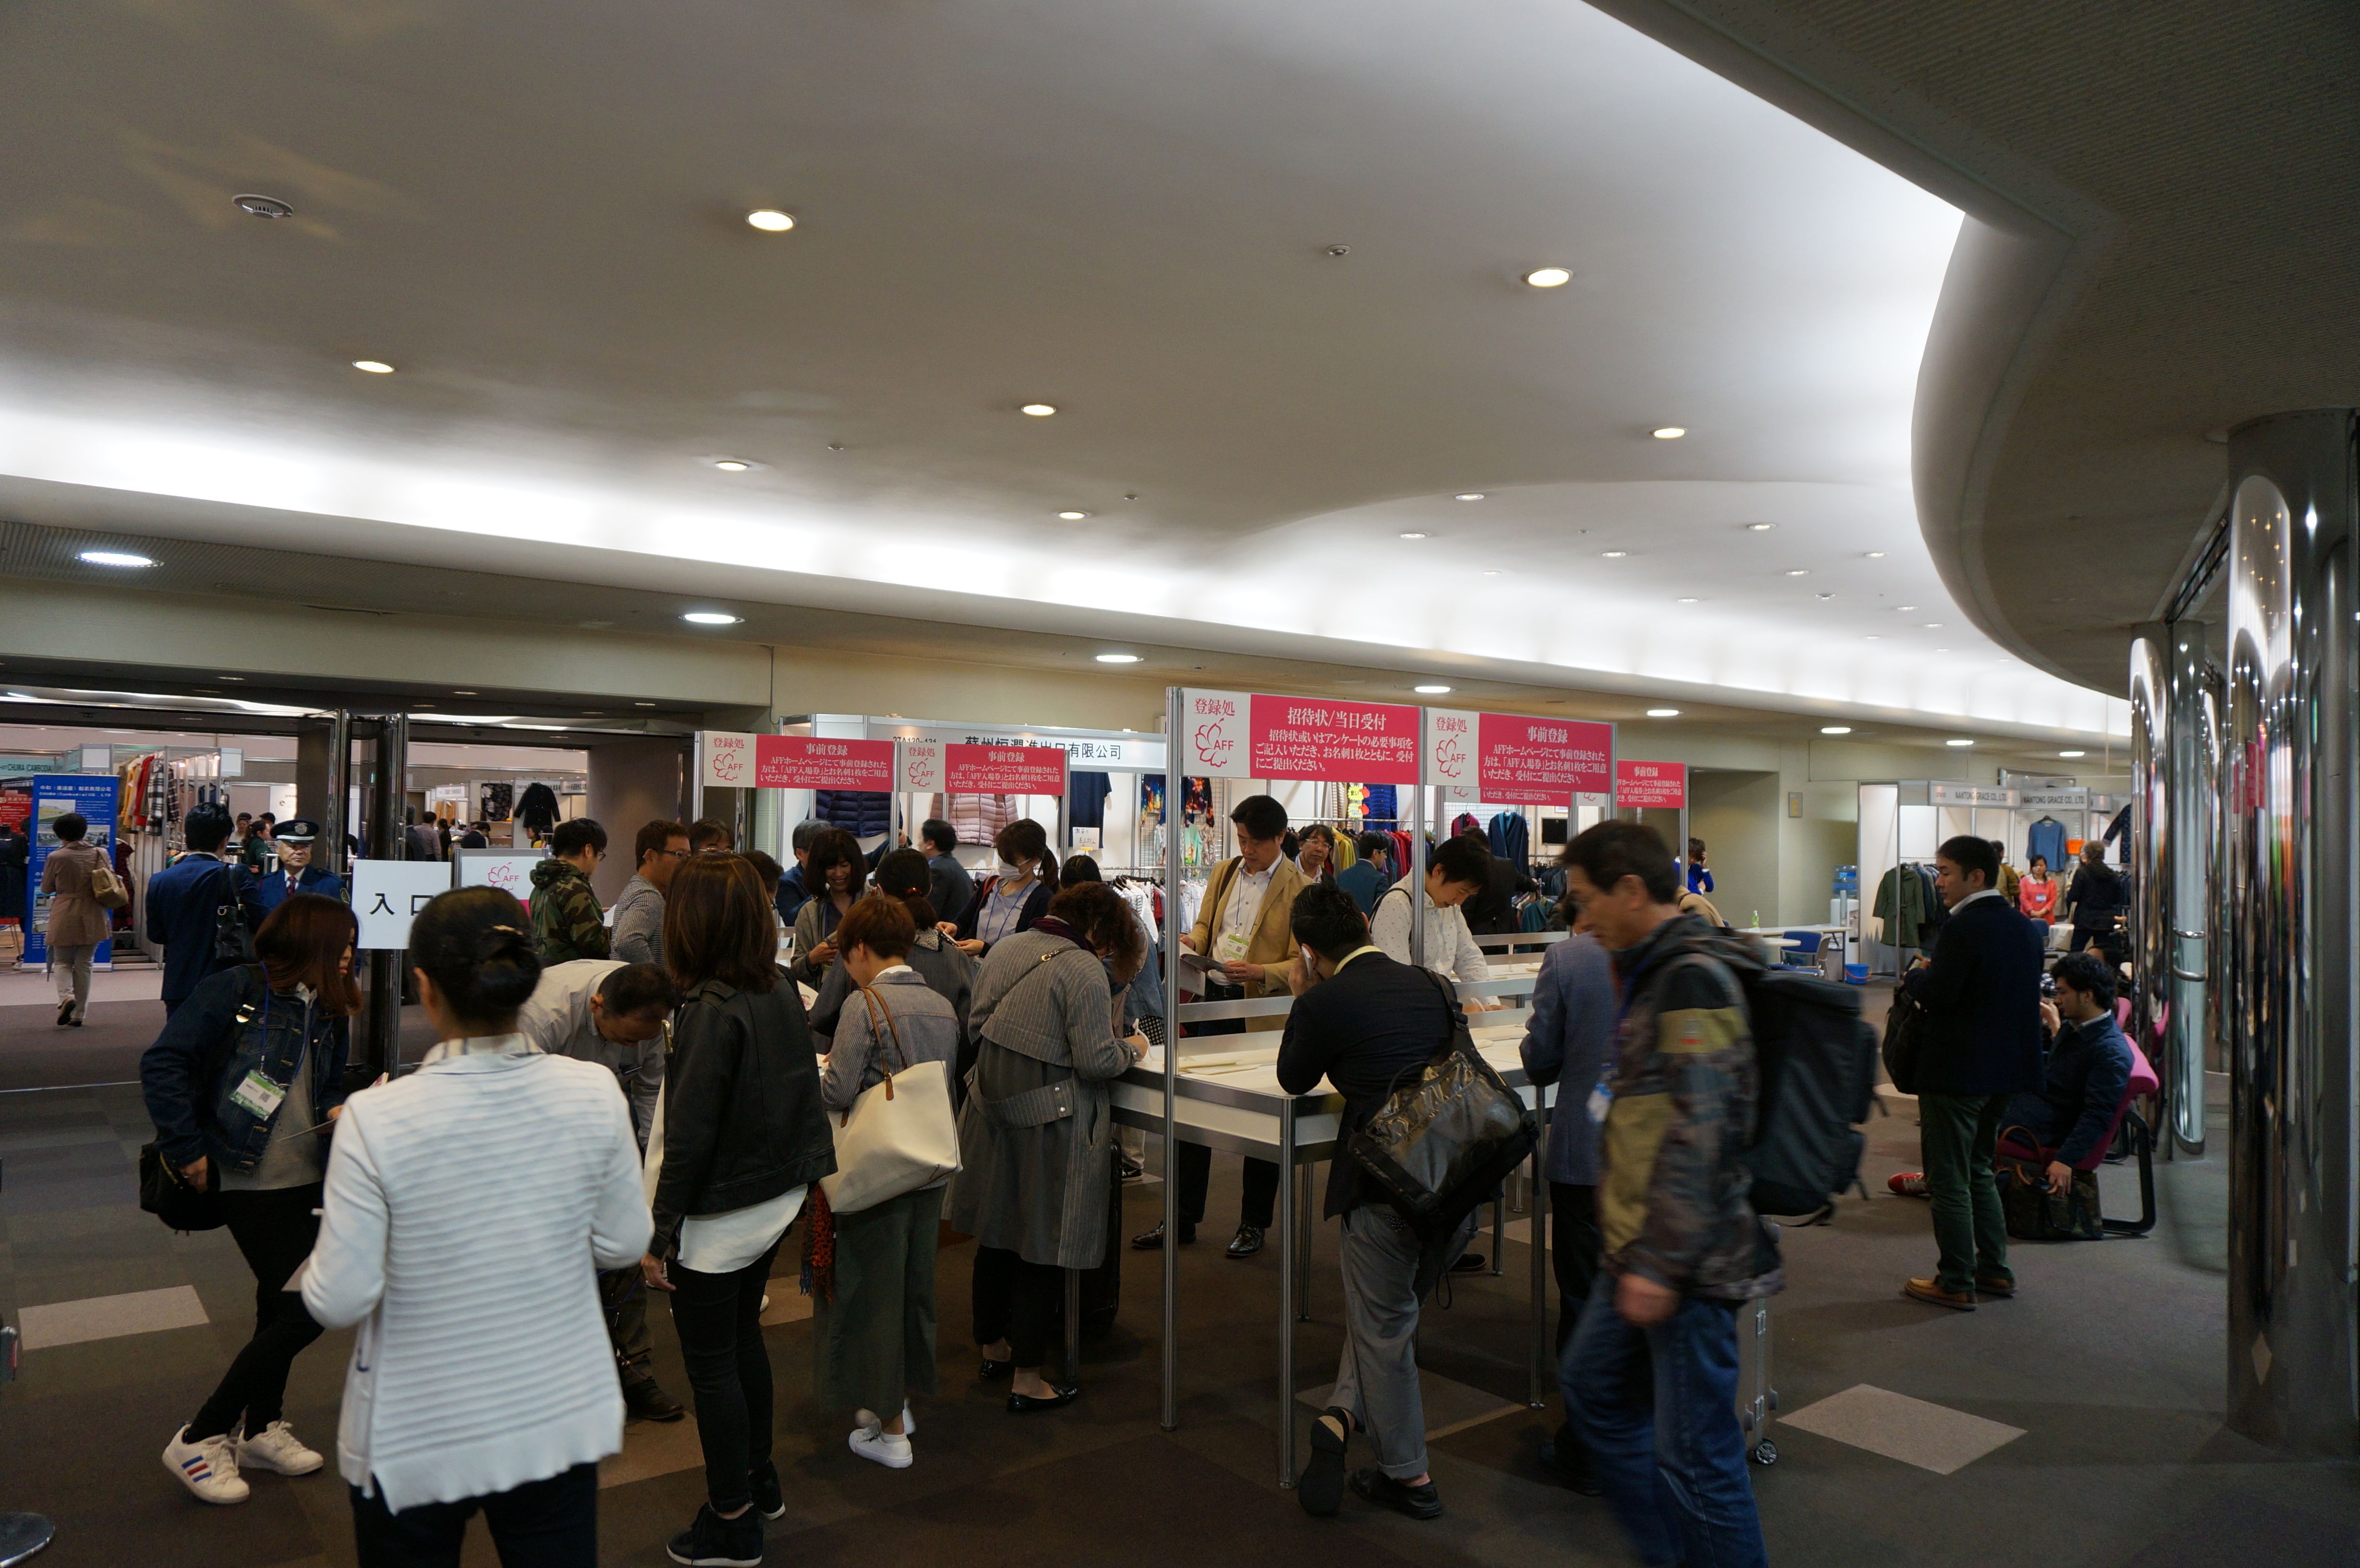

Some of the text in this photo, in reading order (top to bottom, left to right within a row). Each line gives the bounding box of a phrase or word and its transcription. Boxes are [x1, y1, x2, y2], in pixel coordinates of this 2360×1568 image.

[1194, 698, 1236, 716] 登録処
[1287, 707, 1387, 731] 招待状/当日受付
[1436, 717, 1467, 733] 登録処
[1269, 729, 1414, 749] 招待状或いはアンケートの必要事項を
[1527, 725, 1568, 744] 事前登録
[713, 738, 745, 749] 登録処
[805, 743, 848, 756] 事前登録
[1214, 740, 1234, 750] AFF
[908, 747, 935, 757] 登録処
[988, 751, 1025, 762] 事前登録
[1450, 753, 1466, 763] AFF
[1493, 745, 1605, 761] AFFホームページにて事前登録された
[771, 757, 887, 769] AFFホームページにて事前登録された
[958, 763, 1059, 774] AFFホームページにて事前登録された
[1256, 757, 1326, 772] にご提出ください。
[1483, 768, 1581, 784] いただき、受付にご提出ください。
[1635, 766, 1659, 777] 事前登録
[761, 774, 862, 785] いただき、受付にご提出ください。
[949, 780, 1037, 790] いただき、受付にご提出ください。
[2024, 795, 2046, 803] NANTONG
[2047, 796, 2065, 804] GRACE
[369, 893, 434, 916] 入口
